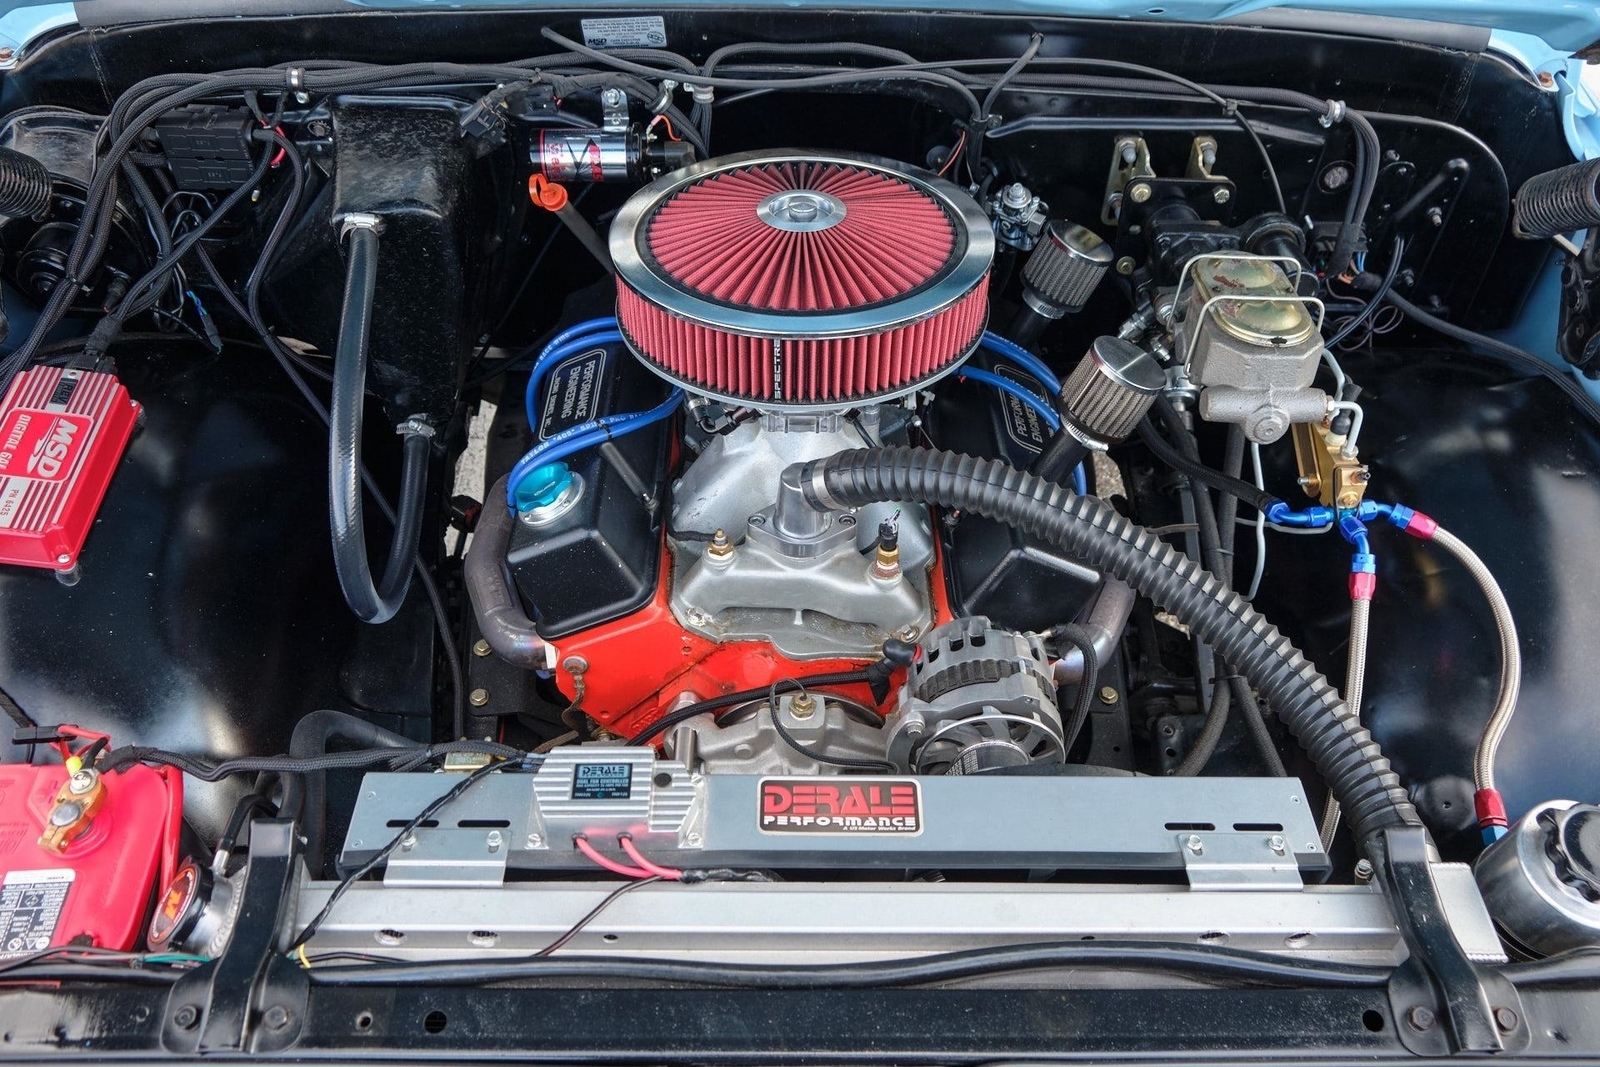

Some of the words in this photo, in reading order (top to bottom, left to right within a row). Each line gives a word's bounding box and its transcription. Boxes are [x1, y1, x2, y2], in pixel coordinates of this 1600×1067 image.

[561, 365, 582, 419] ENGINEERING
[574, 360, 596, 420] PERFORMANCE
[3, 413, 32, 450] DIGITAL
[37, 418, 79, 479] MSD
[521, 441, 550, 465] TAYLOR
[583, 766, 624, 774] DERALE
[764, 785, 915, 815] DERALE
[763, 815, 917, 827] PERFORMANCE
